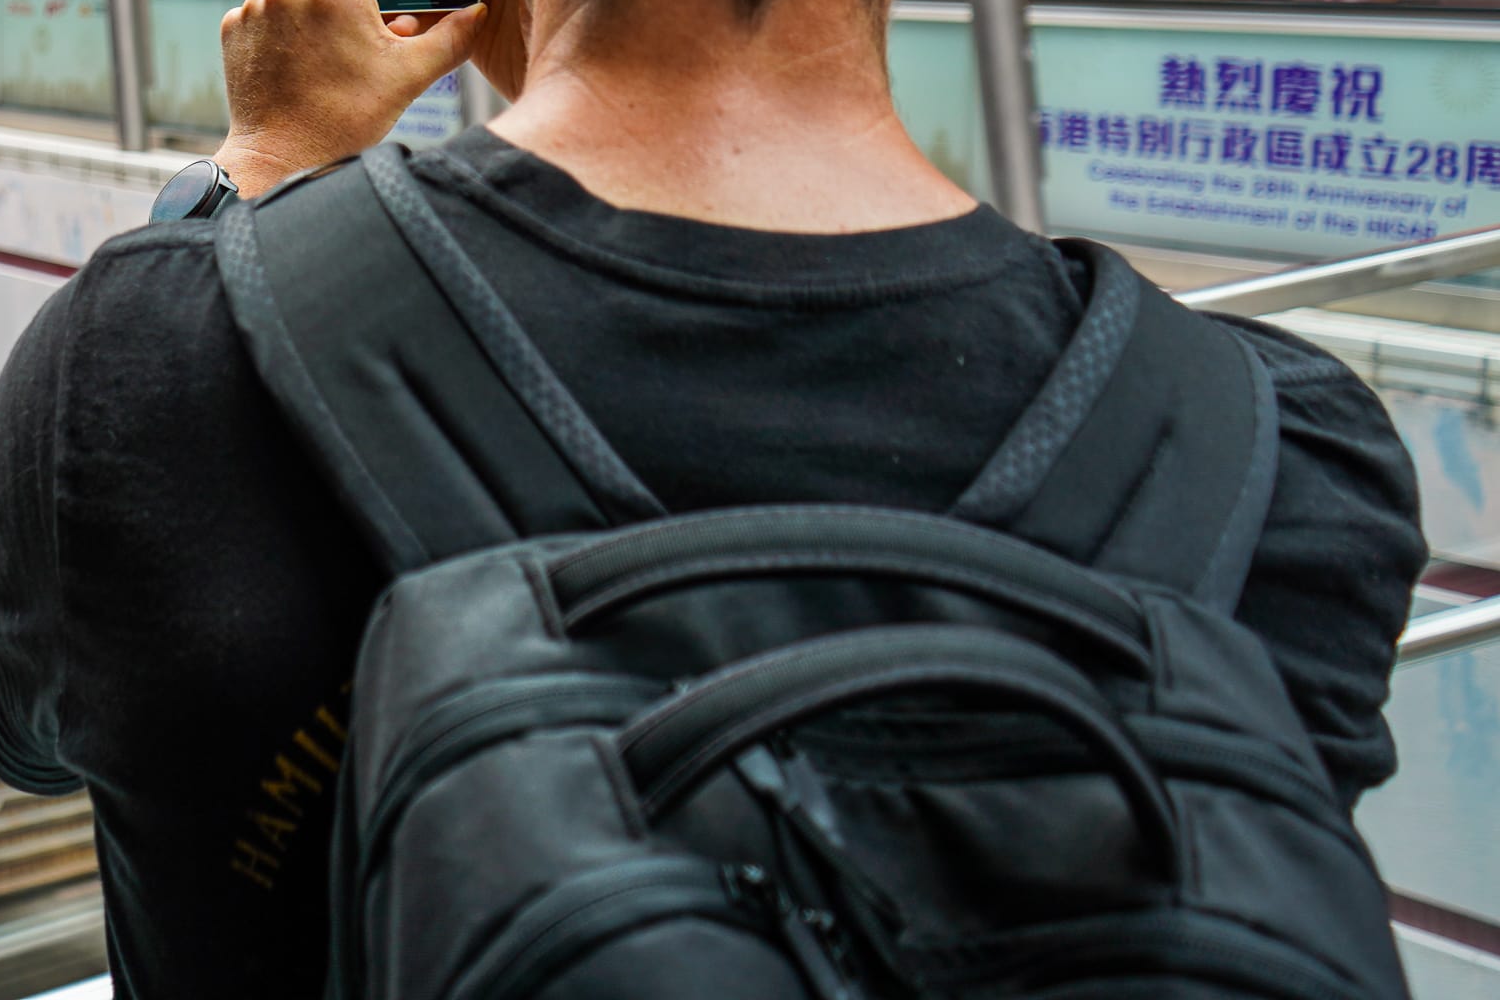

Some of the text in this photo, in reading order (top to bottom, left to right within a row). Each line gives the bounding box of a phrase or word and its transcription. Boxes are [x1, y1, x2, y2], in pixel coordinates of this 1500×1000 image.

[1160, 54, 1383, 122] 熱烈慶祝
[1088, 160, 1205, 194] Celebrating
[1210, 173, 1246, 194] the
[1306, 181, 1436, 215] Anniversary
[1442, 194, 1468, 218] of
[1322, 212, 1359, 236] the
